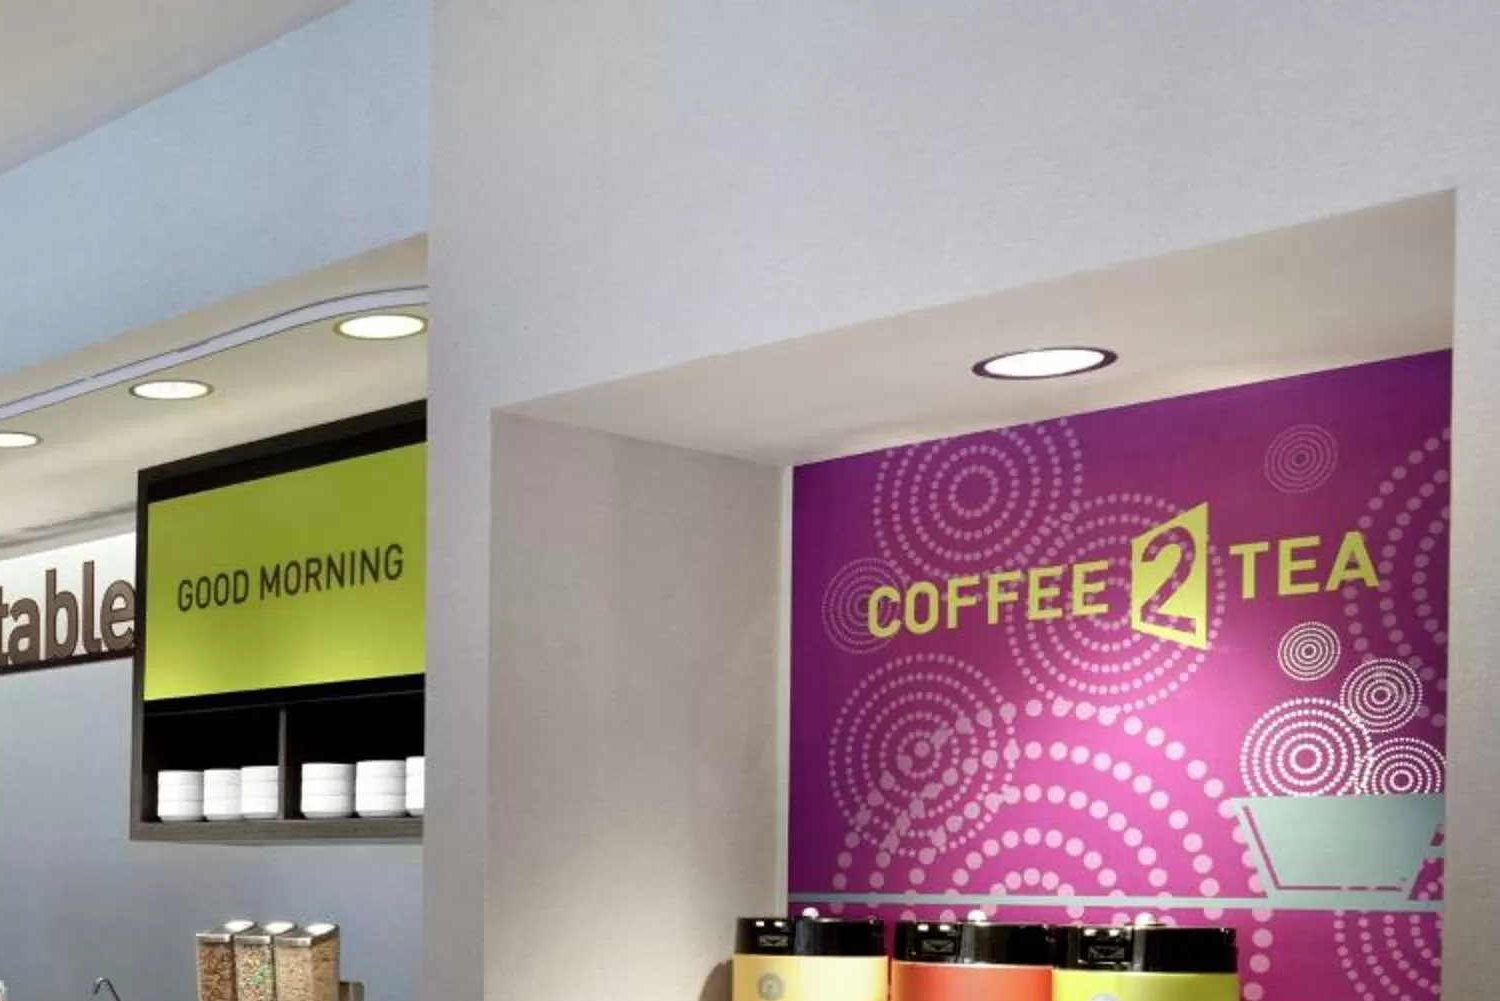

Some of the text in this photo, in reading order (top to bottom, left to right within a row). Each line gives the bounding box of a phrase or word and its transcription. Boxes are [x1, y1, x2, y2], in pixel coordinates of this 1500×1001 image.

[177, 543, 404, 613] GOOD MORNING
[867, 523, 1380, 638] COFFEE 2 TEA
